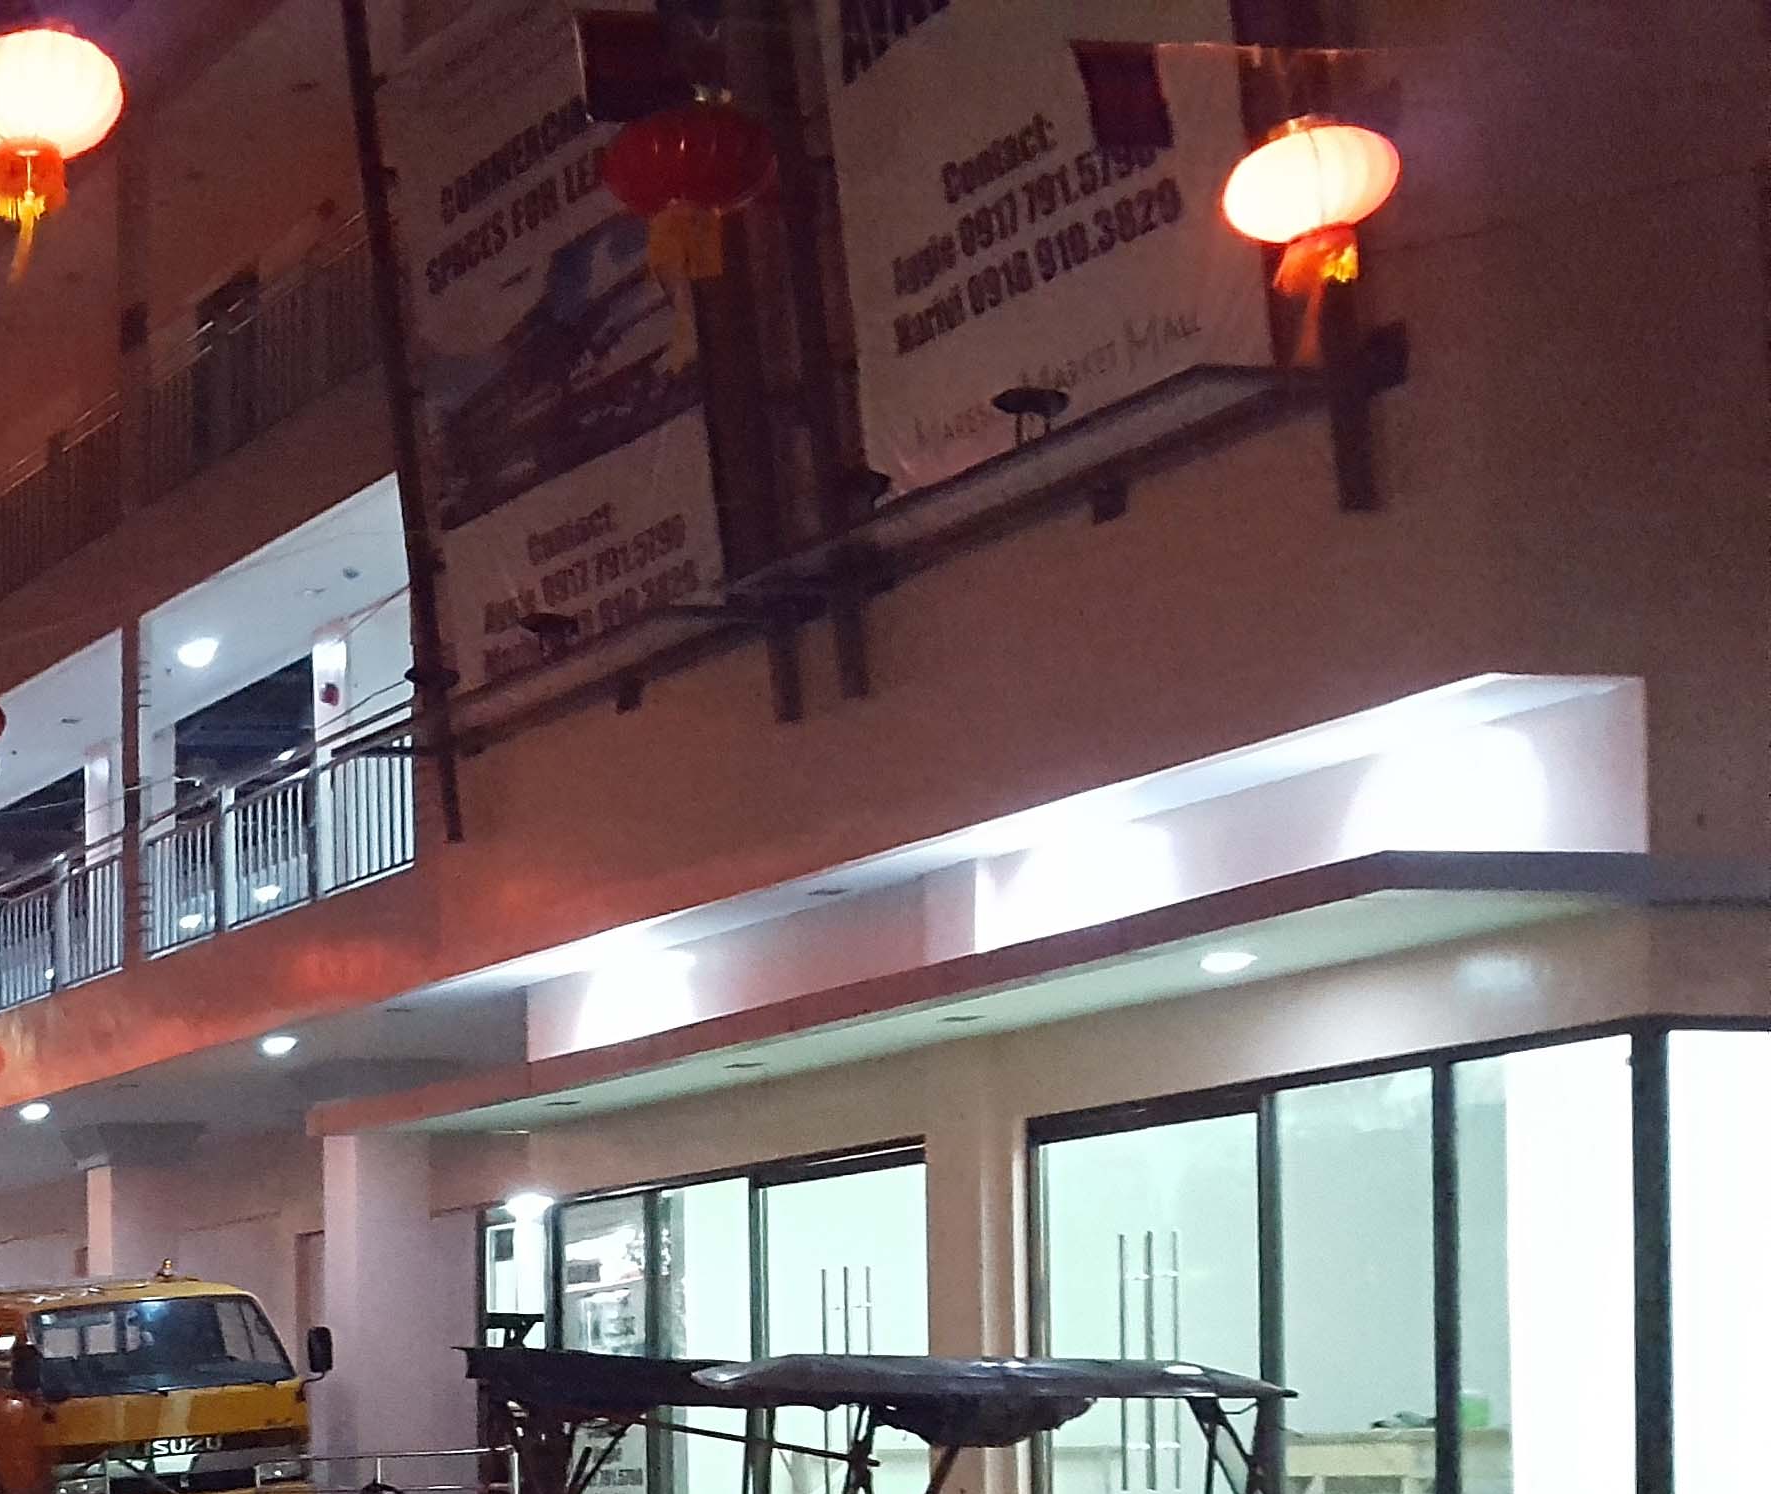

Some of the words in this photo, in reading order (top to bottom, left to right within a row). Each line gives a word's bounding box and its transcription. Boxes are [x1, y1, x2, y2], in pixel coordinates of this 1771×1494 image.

[511, 177, 559, 238] FOR
[959, 192, 1019, 256] 0917
[145, 1437, 223, 1457] ISUZU
